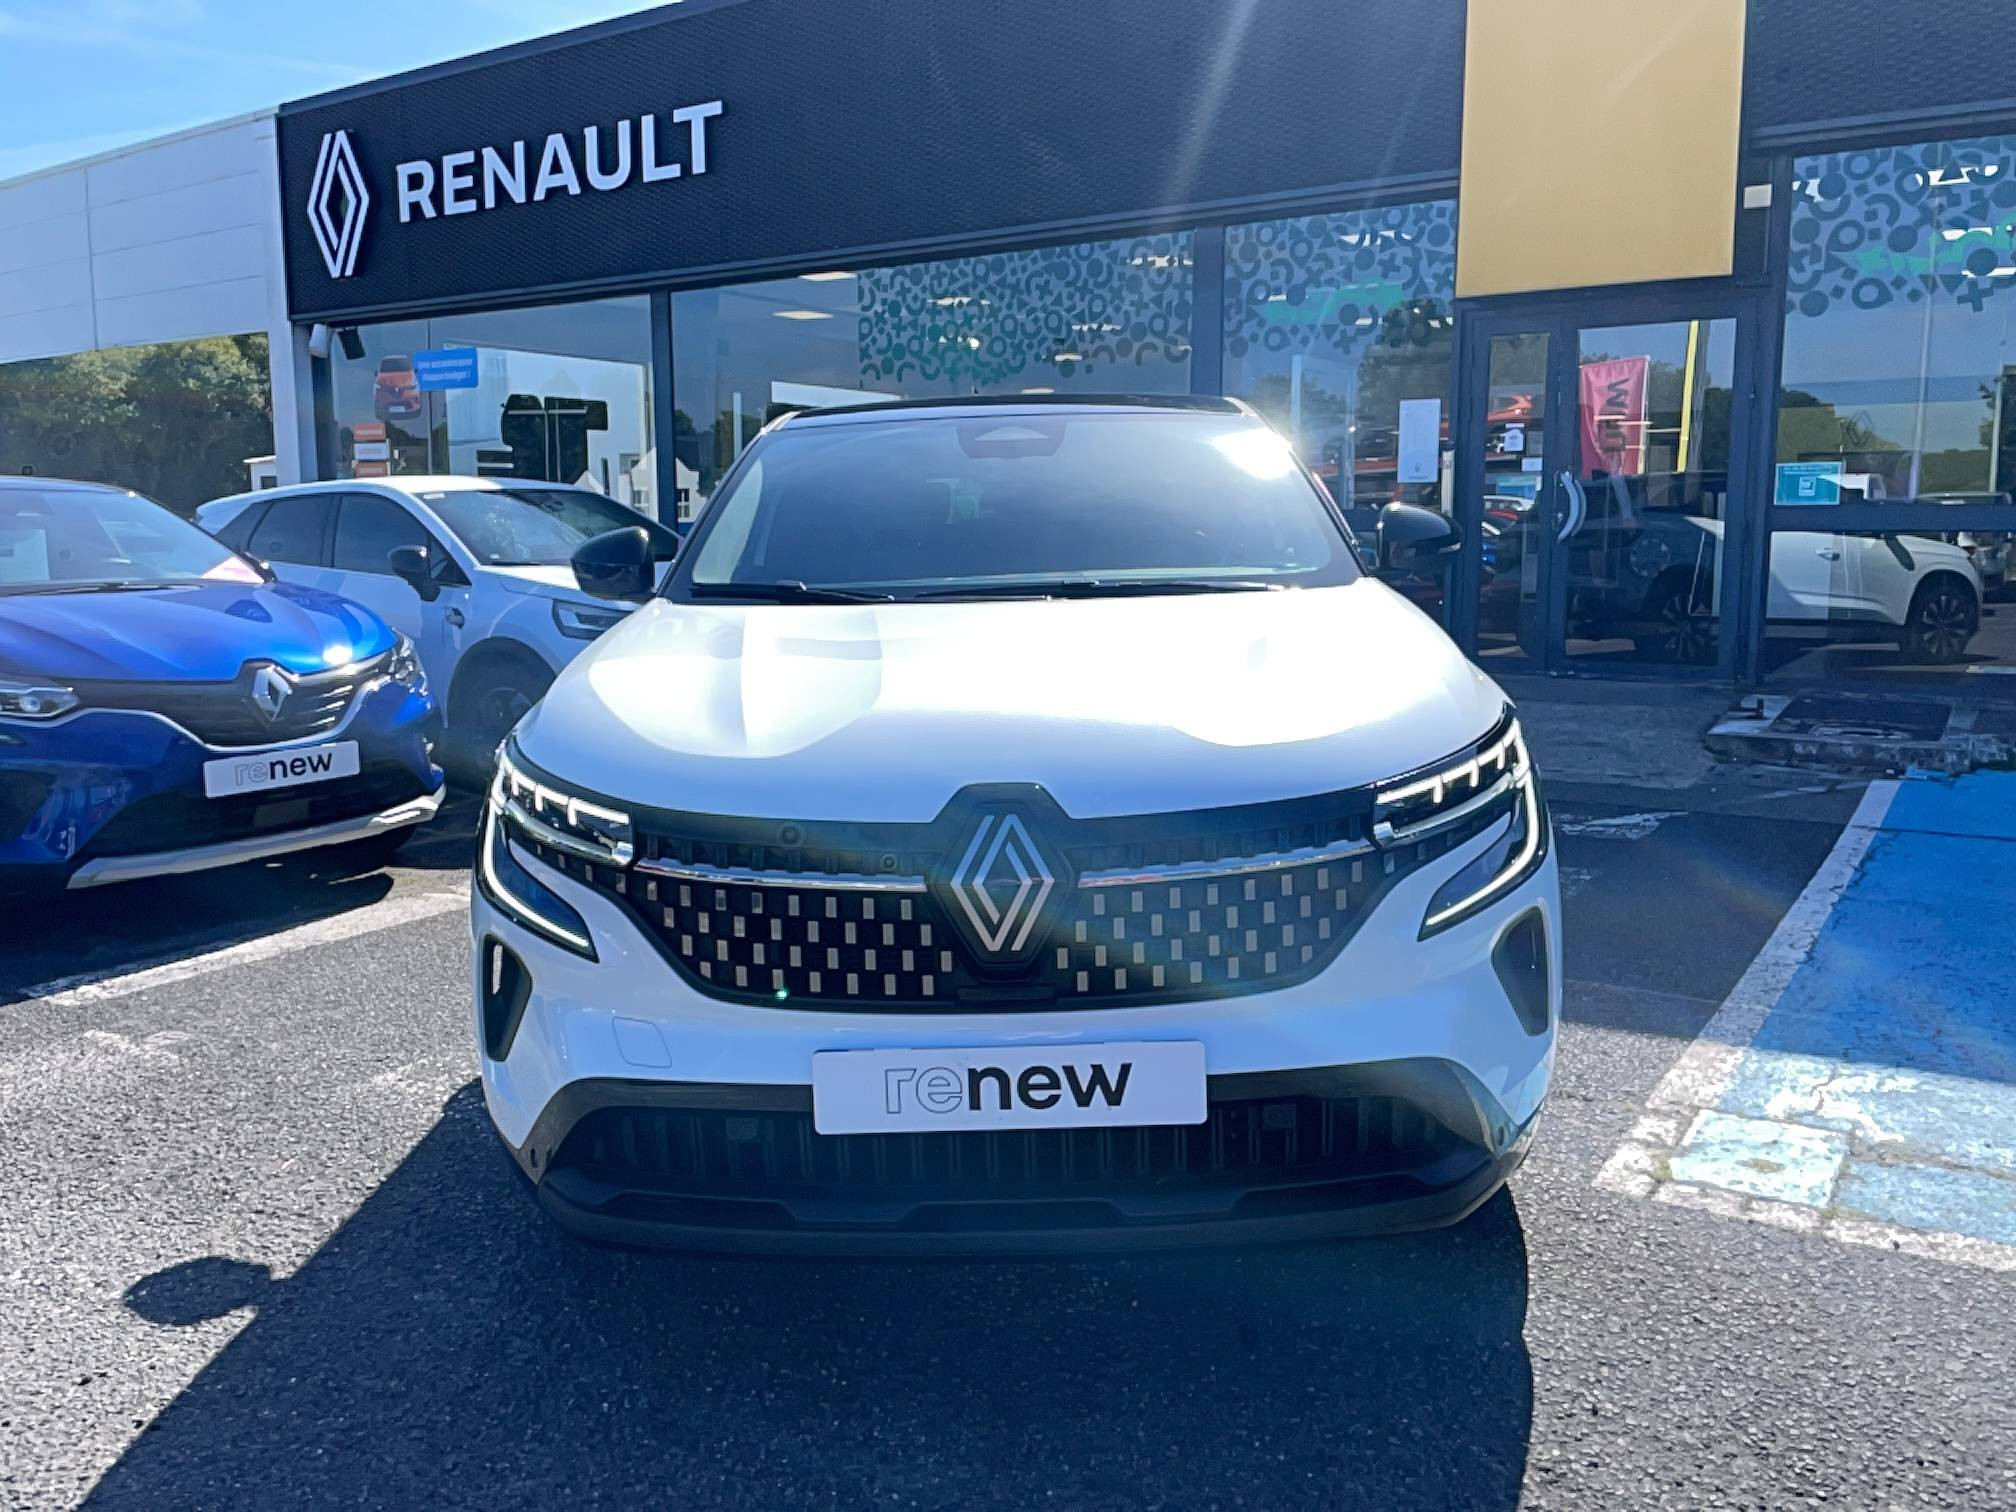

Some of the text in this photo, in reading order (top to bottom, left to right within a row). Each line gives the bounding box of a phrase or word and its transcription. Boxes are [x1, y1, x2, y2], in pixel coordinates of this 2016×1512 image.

[396, 100, 724, 224] RENAULT
[234, 751, 333, 787] renew
[884, 1062, 1133, 1115] renew
